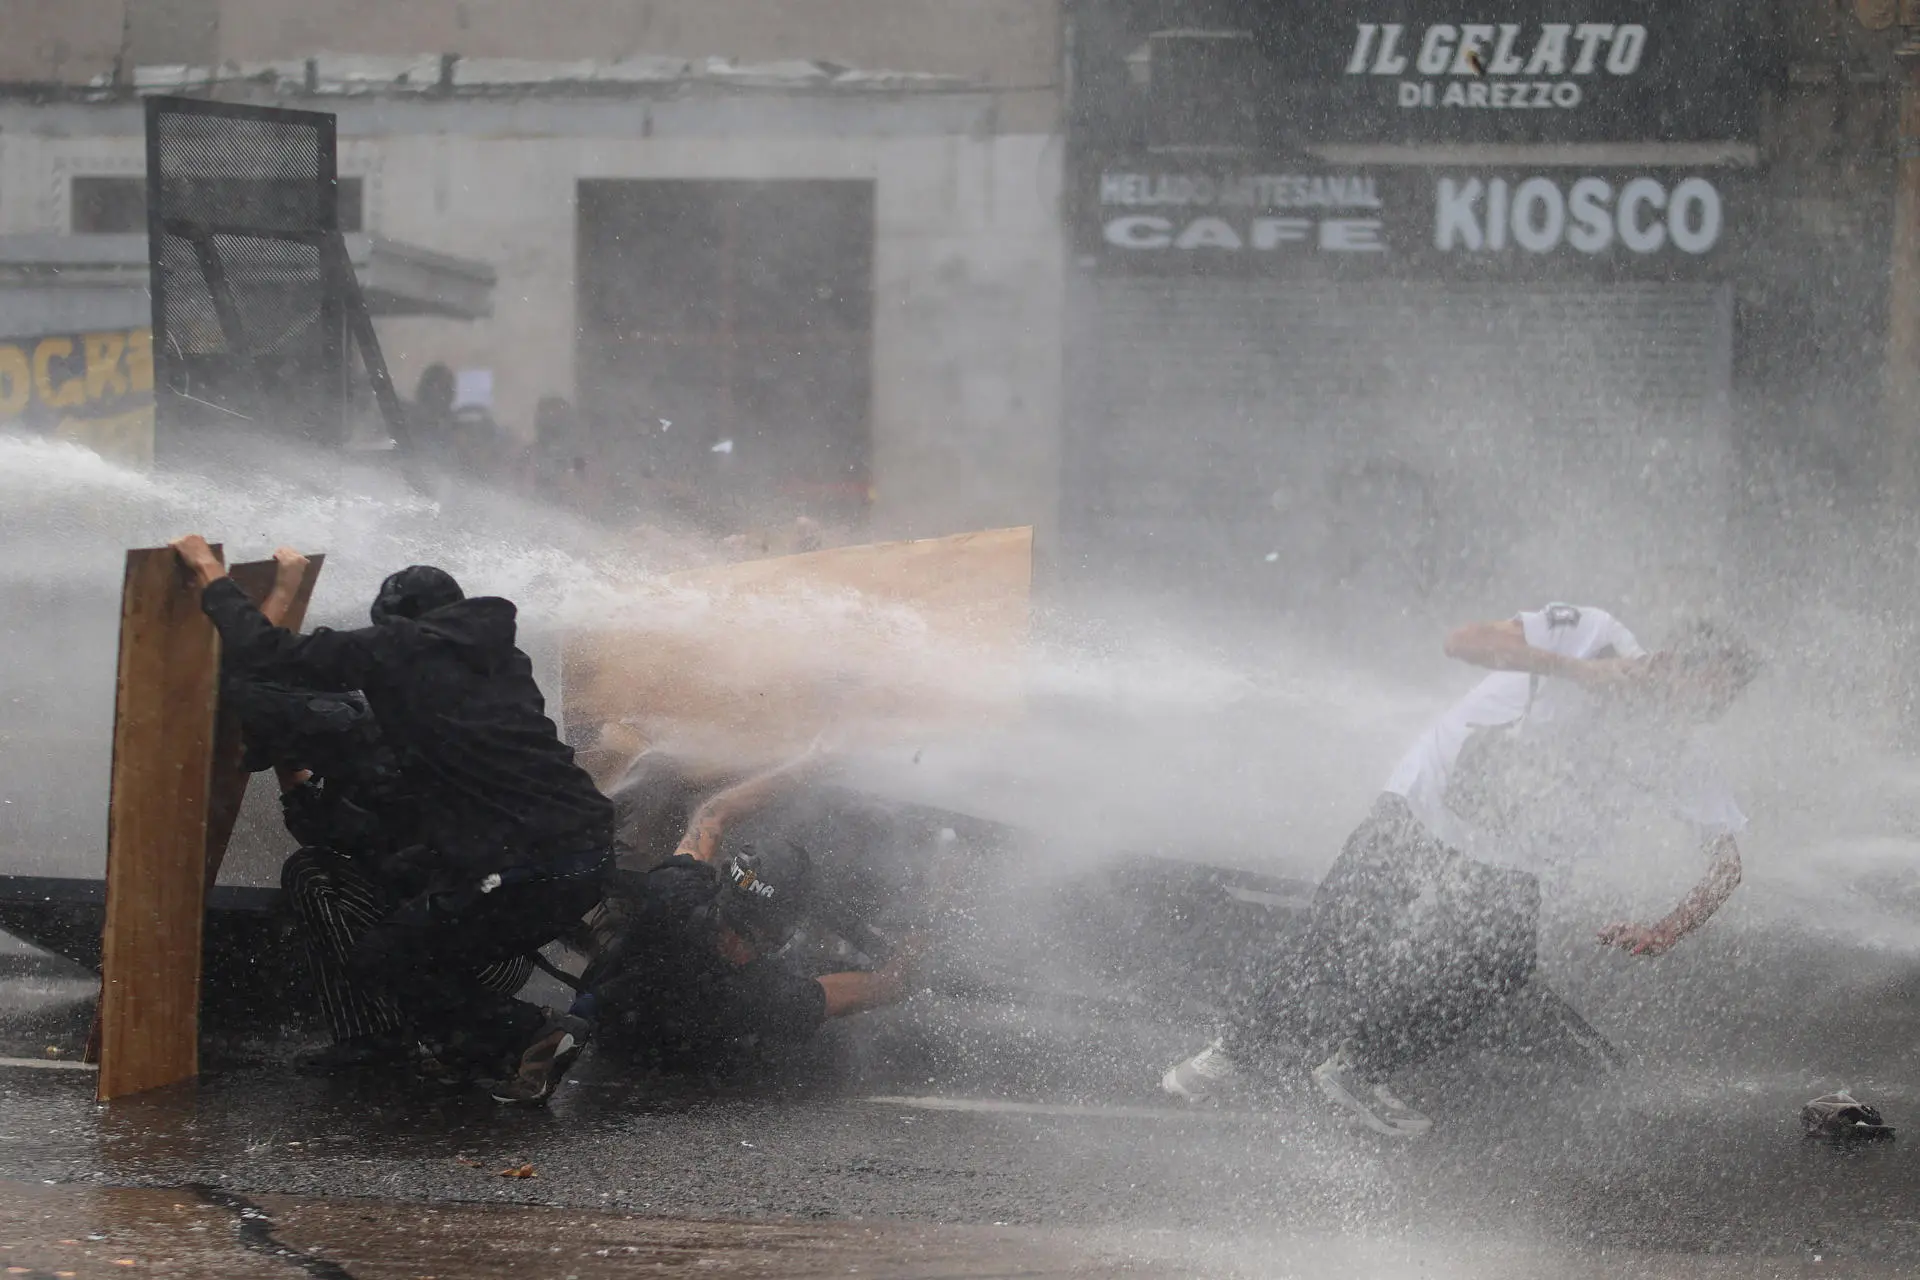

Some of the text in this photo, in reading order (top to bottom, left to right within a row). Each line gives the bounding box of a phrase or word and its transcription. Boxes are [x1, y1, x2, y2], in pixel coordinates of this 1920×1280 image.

[1345, 23, 1648, 75] IL GELATO
[1399, 82, 1582, 109] DI AREZZO
[1103, 216, 1390, 250] CAFE
[1435, 178, 1722, 254] KIOSCO
